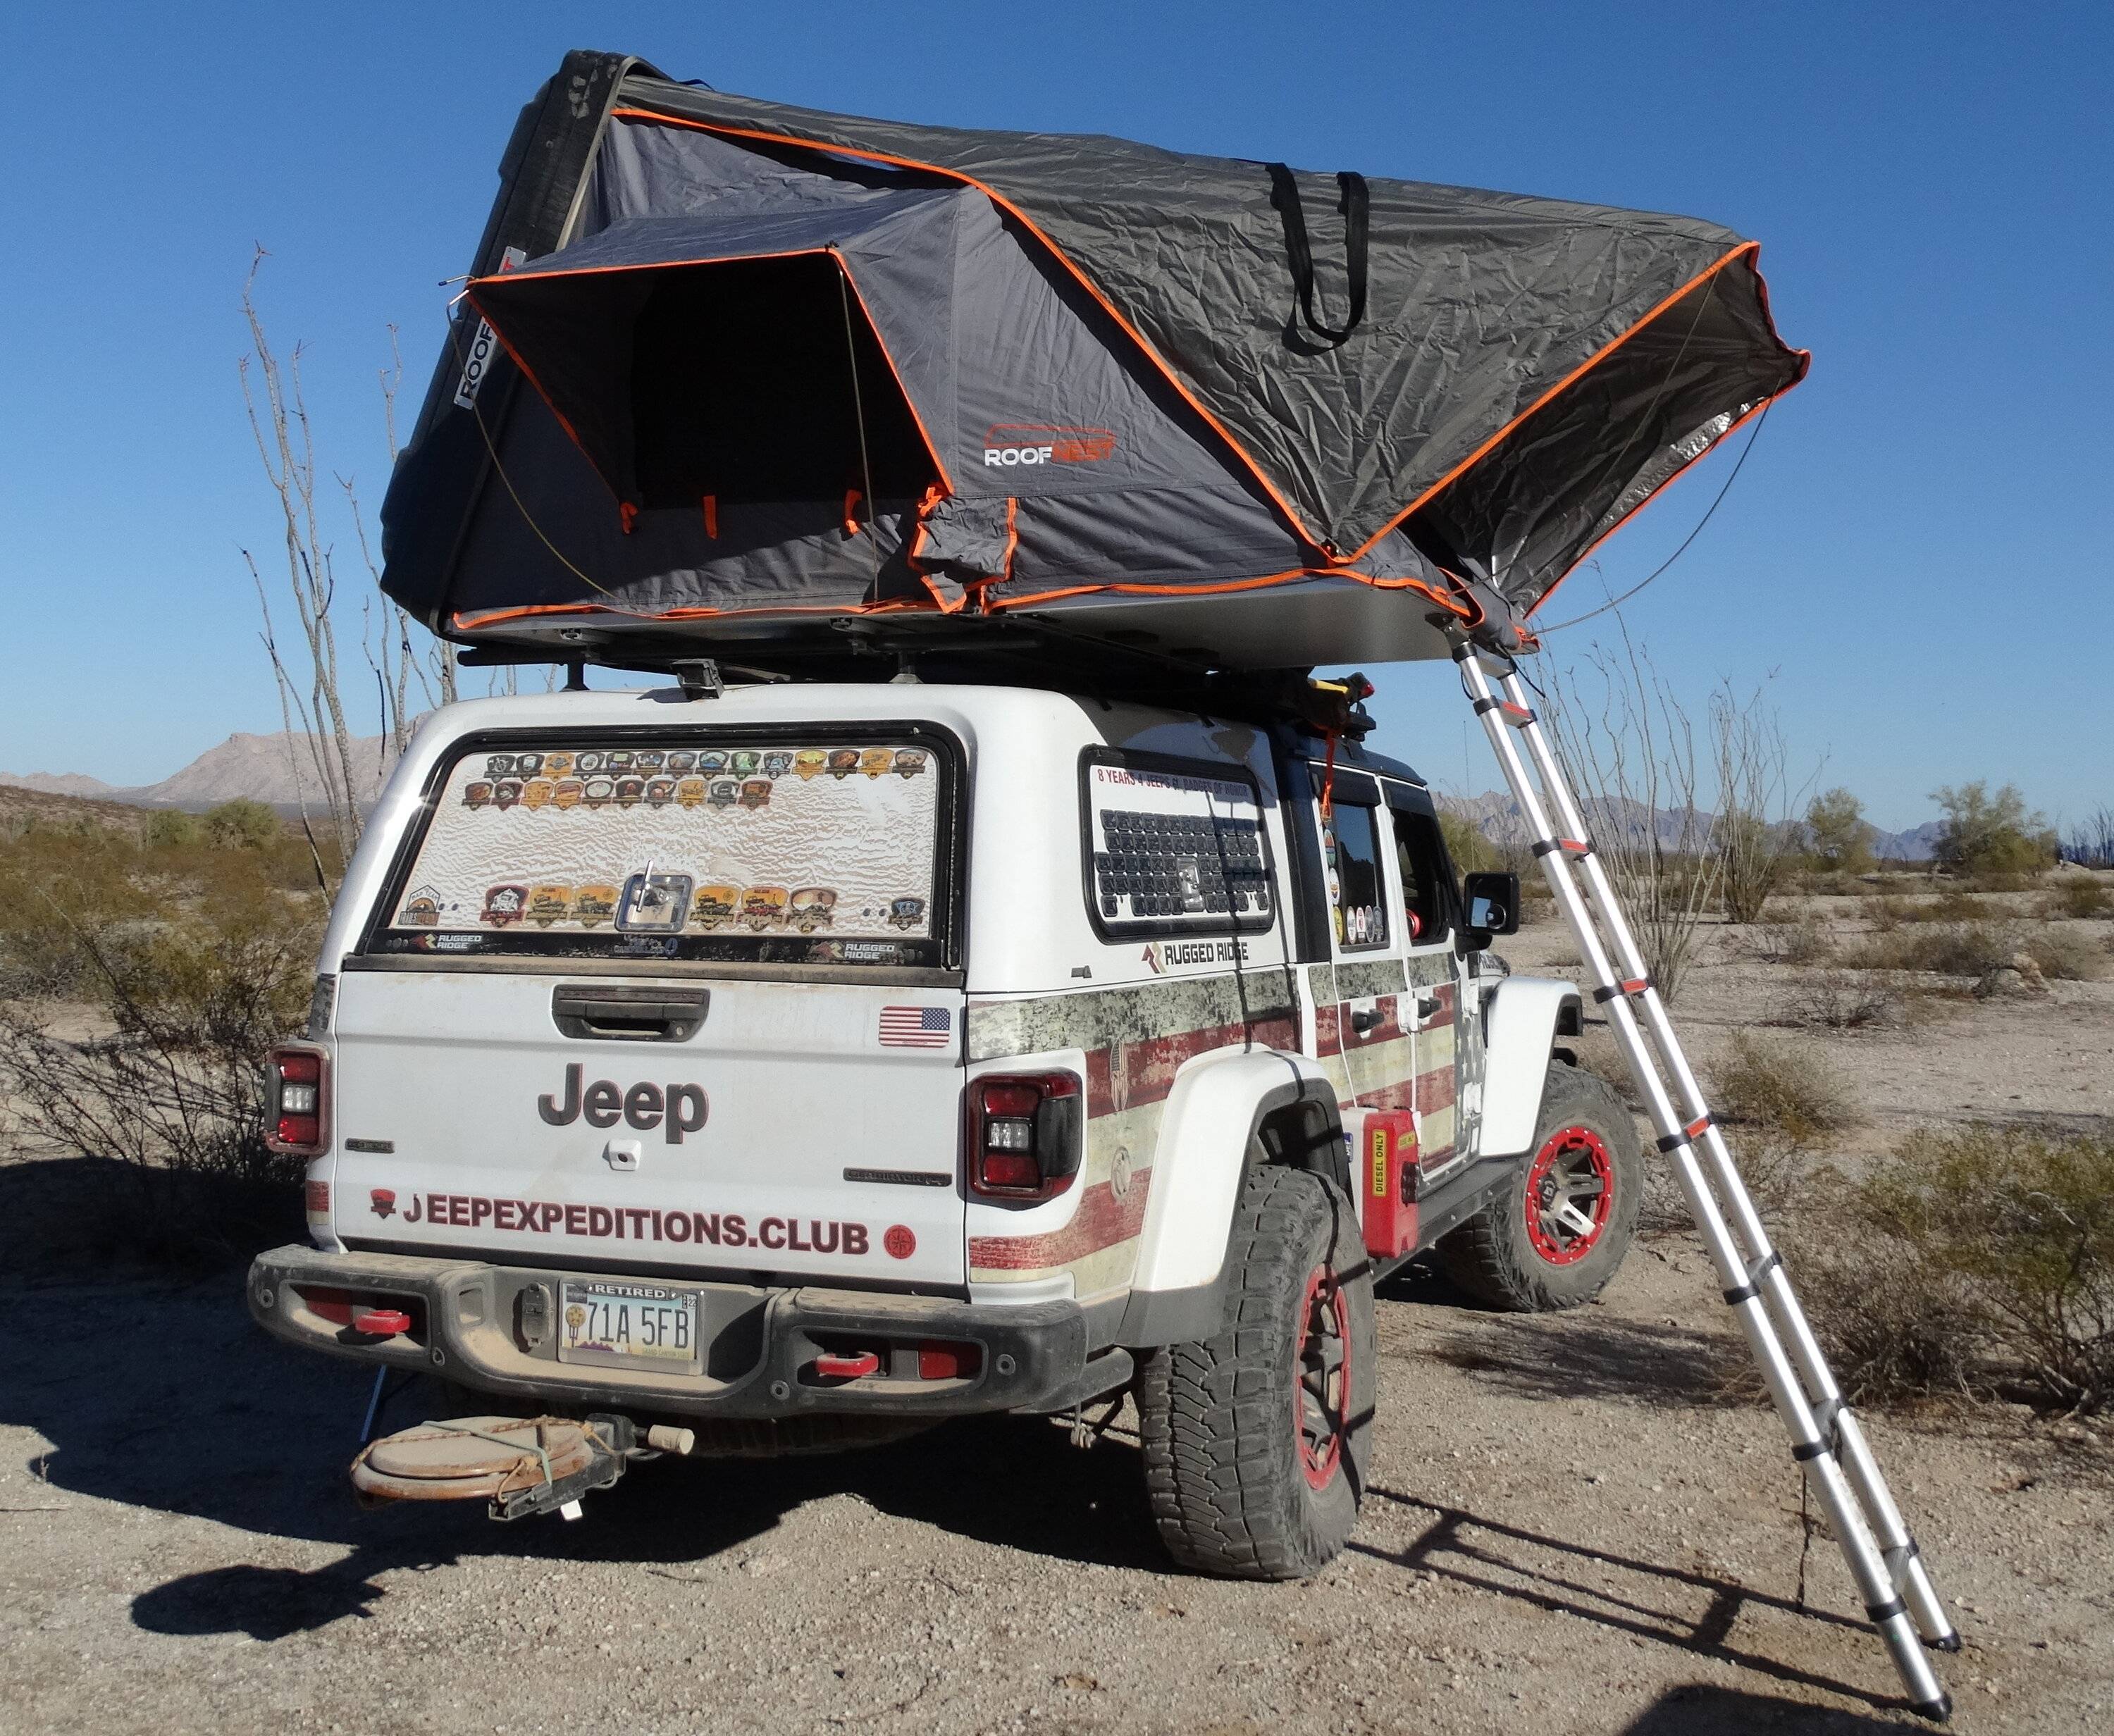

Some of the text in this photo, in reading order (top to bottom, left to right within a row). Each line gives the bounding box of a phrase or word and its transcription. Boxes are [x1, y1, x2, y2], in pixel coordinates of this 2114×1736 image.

[1097, 769, 1104, 782] 8
[1106, 769, 1135, 786] YEARS
[845, 943, 895, 952] RUGGED
[1164, 941, 1249, 965] RUGGED RIDGE
[538, 1062, 710, 1145] Jeep
[1376, 1134, 1384, 1193] DIESEL ONLY
[403, 1193, 870, 1256] JEEPEXPEDITIONS.CLUB
[595, 1284, 666, 1298] RETIRED
[588, 1301, 688, 1348] 71A 5FB
